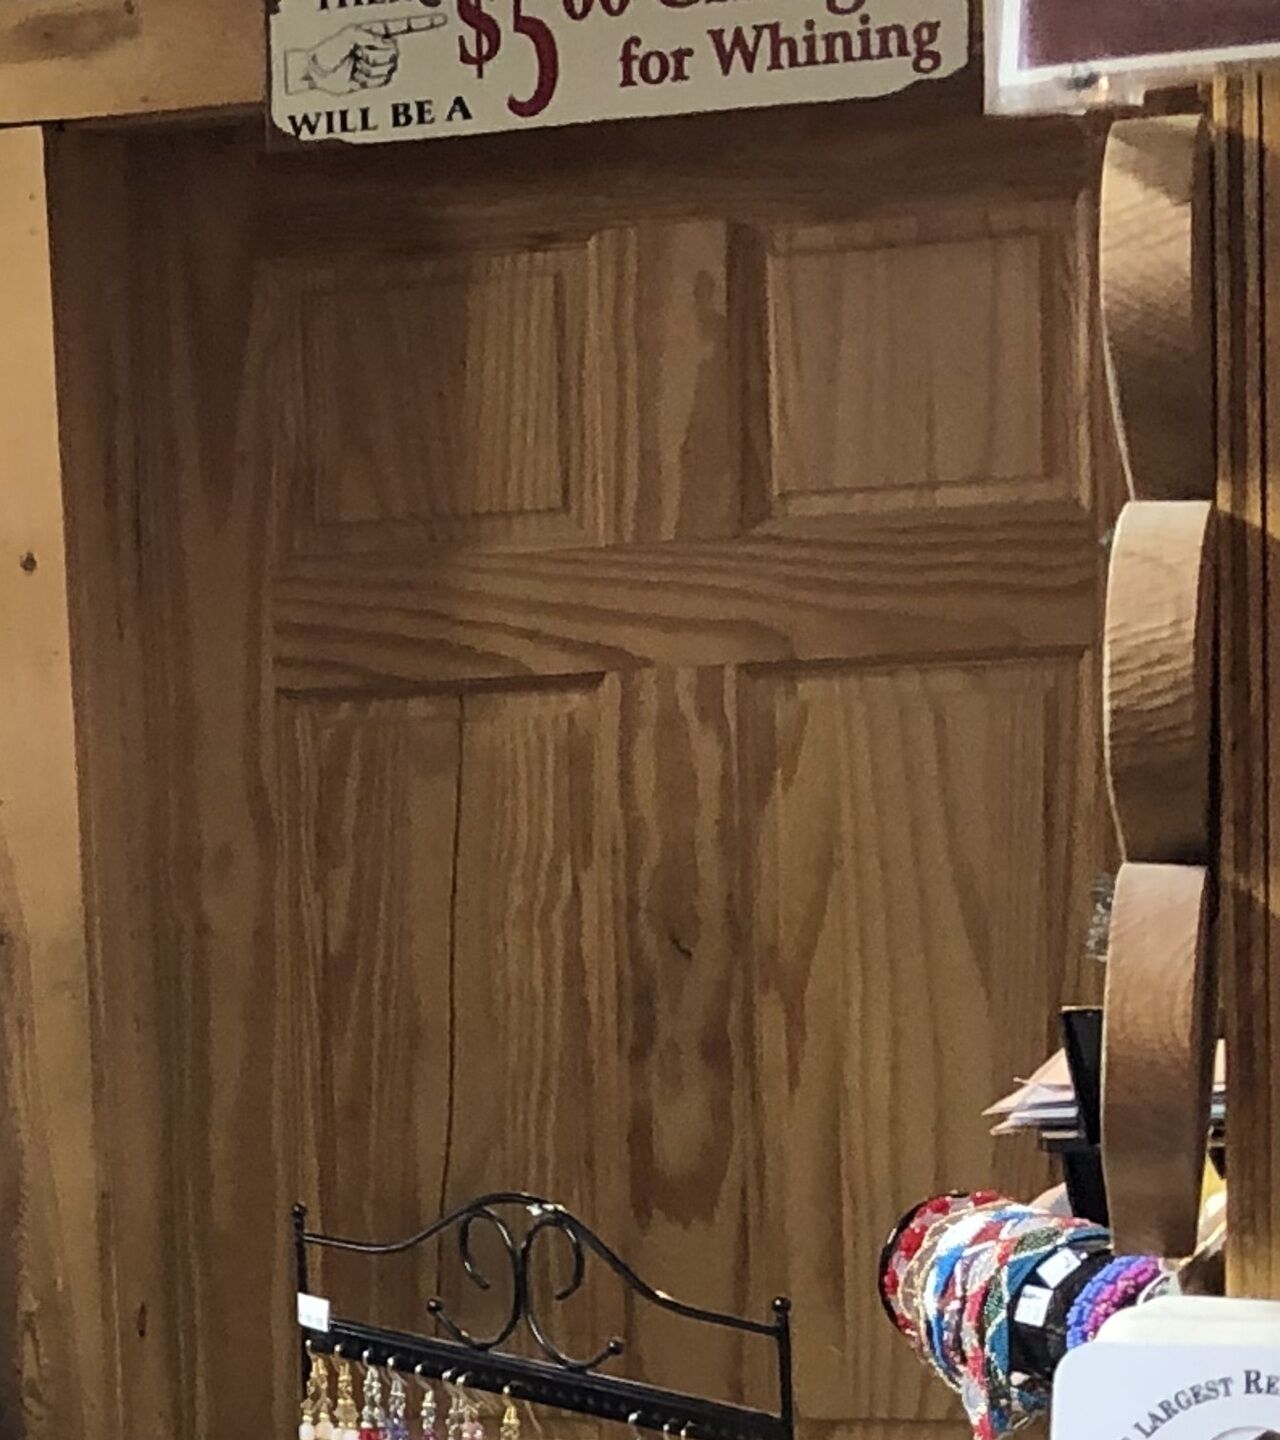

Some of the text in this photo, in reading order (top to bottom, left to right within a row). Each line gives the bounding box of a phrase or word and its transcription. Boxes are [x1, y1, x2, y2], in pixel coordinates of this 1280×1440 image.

[618, 13, 942, 88] for Whining
[287, 95, 473, 138] WILL BE A
[1133, 1376, 1235, 1440] LARGEST
